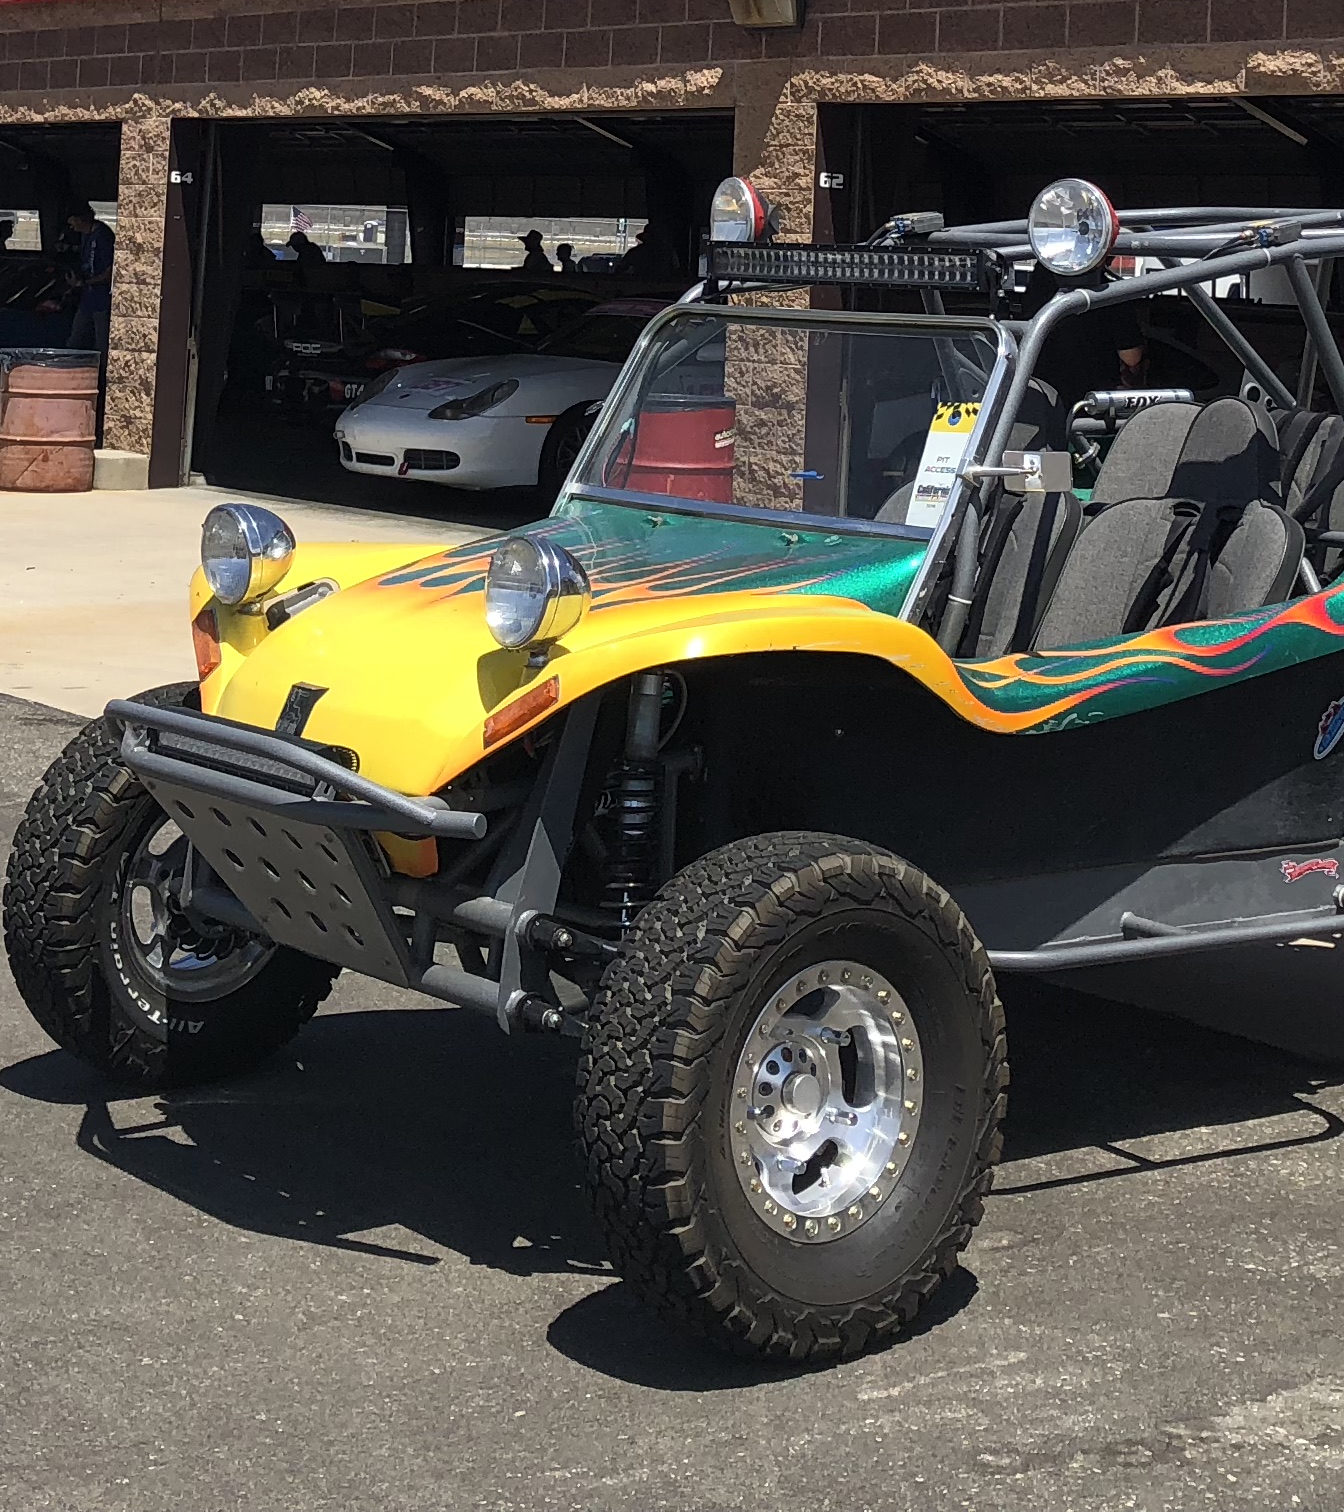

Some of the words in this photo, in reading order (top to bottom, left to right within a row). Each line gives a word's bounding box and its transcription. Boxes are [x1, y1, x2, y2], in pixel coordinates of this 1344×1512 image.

[170, 170, 194, 184] 64
[819, 171, 844, 189] 62
[1125, 395, 1161, 409] FOX
[936, 456, 950, 464] PIT
[924, 465, 957, 474] ACCESS
